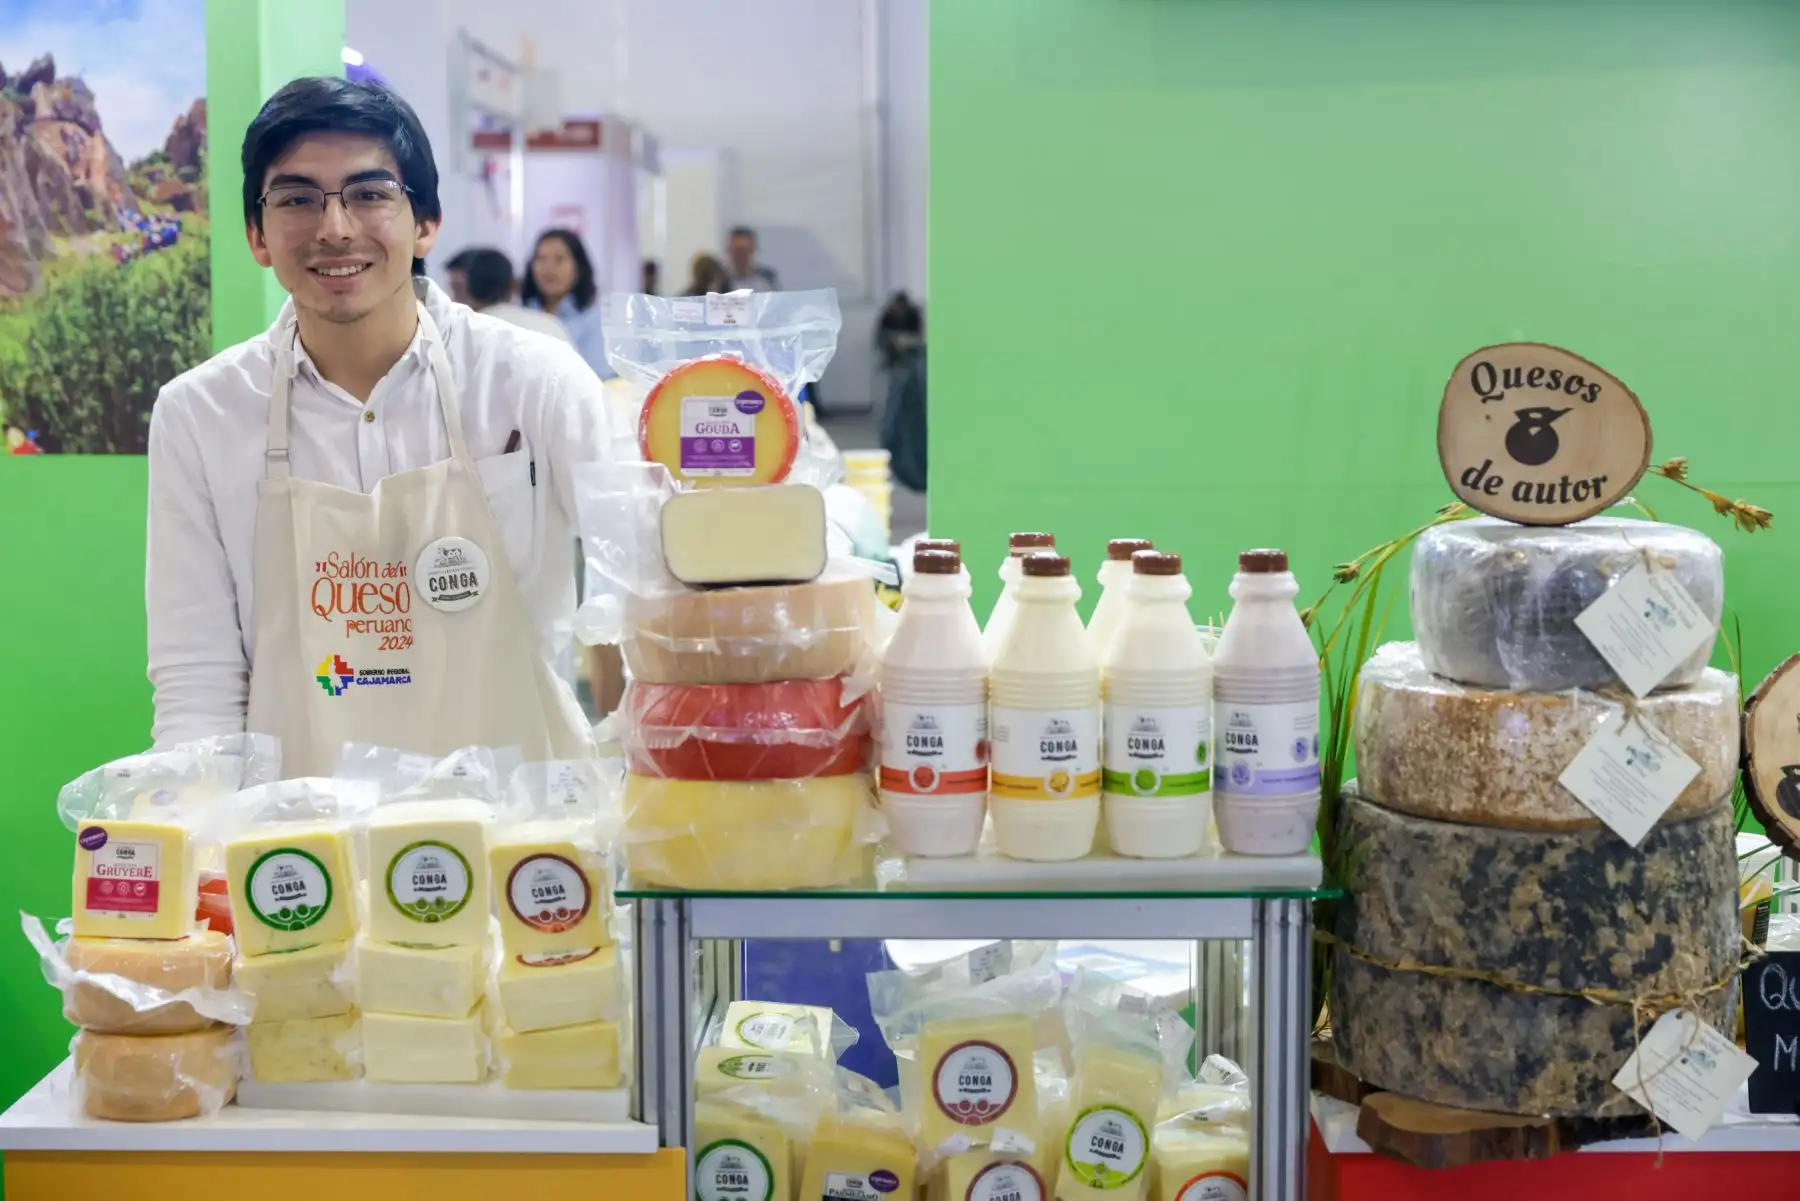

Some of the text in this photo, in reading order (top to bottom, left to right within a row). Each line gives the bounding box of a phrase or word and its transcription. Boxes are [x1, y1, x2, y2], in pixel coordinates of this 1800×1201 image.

[1470, 361, 1602, 404] Quesos
[695, 422, 741, 435] GOUDA
[1460, 459, 1608, 505] de autor
[326, 551, 402, 579] Salón del
[429, 571, 478, 593] CONGA
[311, 577, 411, 622] Queso
[346, 618, 413, 639] peruano
[378, 636, 414, 651] 2024
[356, 675, 412, 686] CAJAMARCA
[906, 734, 944, 748] CONGA
[1127, 737, 1165, 751] CONGA
[1225, 731, 1259, 746] CONGA
[1040, 739, 1078, 754] CONGA
[96, 863, 153, 879] GRUYERE
[412, 873, 448, 886] CONGA
[271, 880, 307, 896] CONGA
[531, 885, 566, 899] CONGA
[958, 1075, 992, 1086] CONGA
[1090, 1135, 1125, 1154] CONGA
[715, 1173, 749, 1186] CONGA
